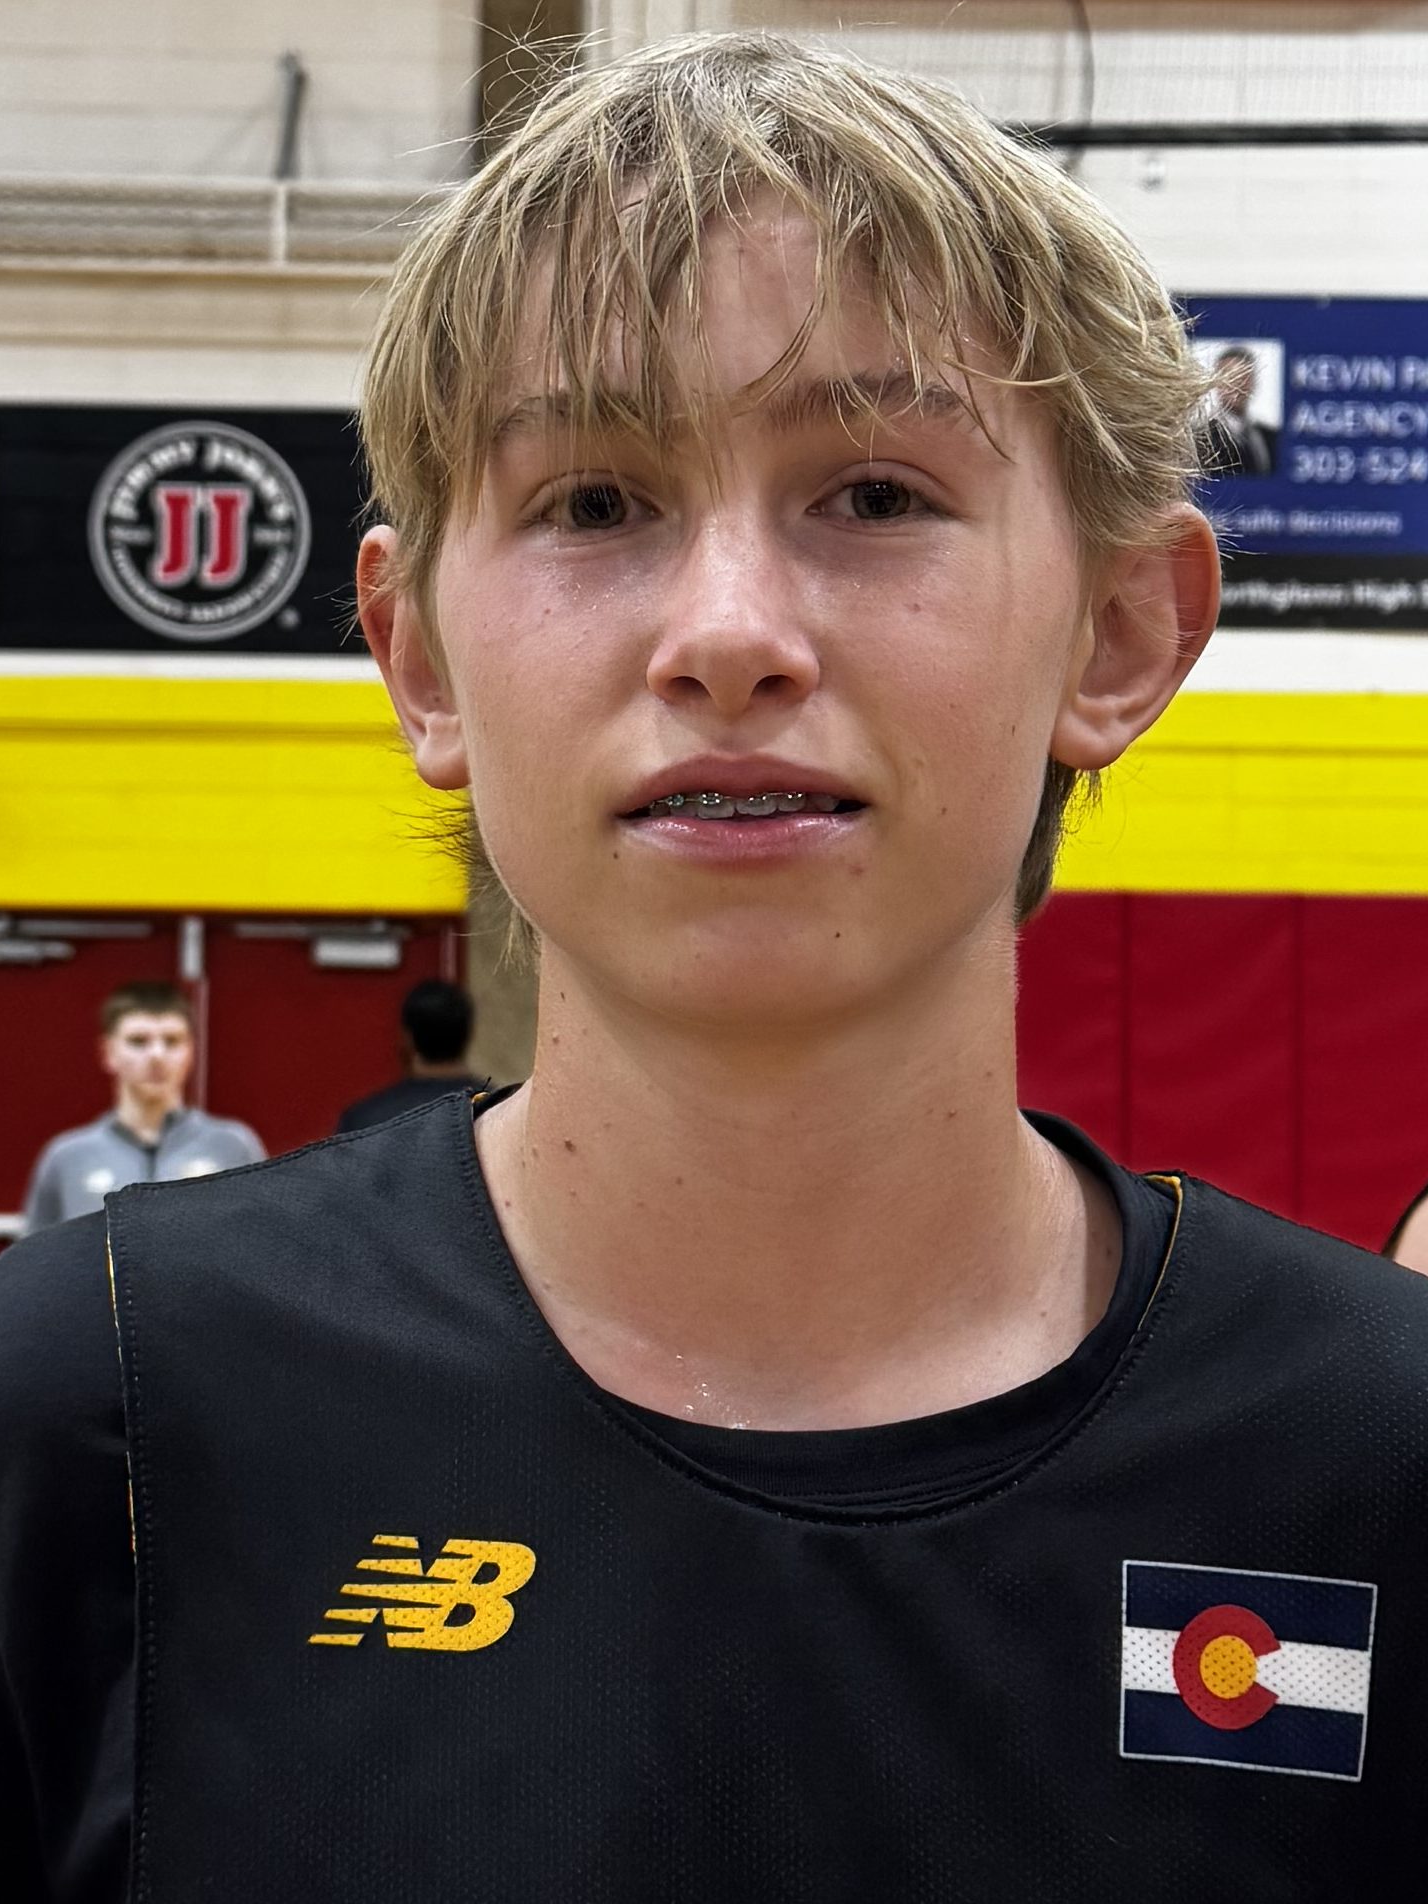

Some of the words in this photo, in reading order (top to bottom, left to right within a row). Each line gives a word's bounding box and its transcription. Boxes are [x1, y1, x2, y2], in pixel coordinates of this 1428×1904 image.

[1292, 355, 1395, 391] KEVIN
[151, 482, 252, 586] JJ
[1221, 580, 1345, 613] orthglenn
[1352, 580, 1416, 614] High
